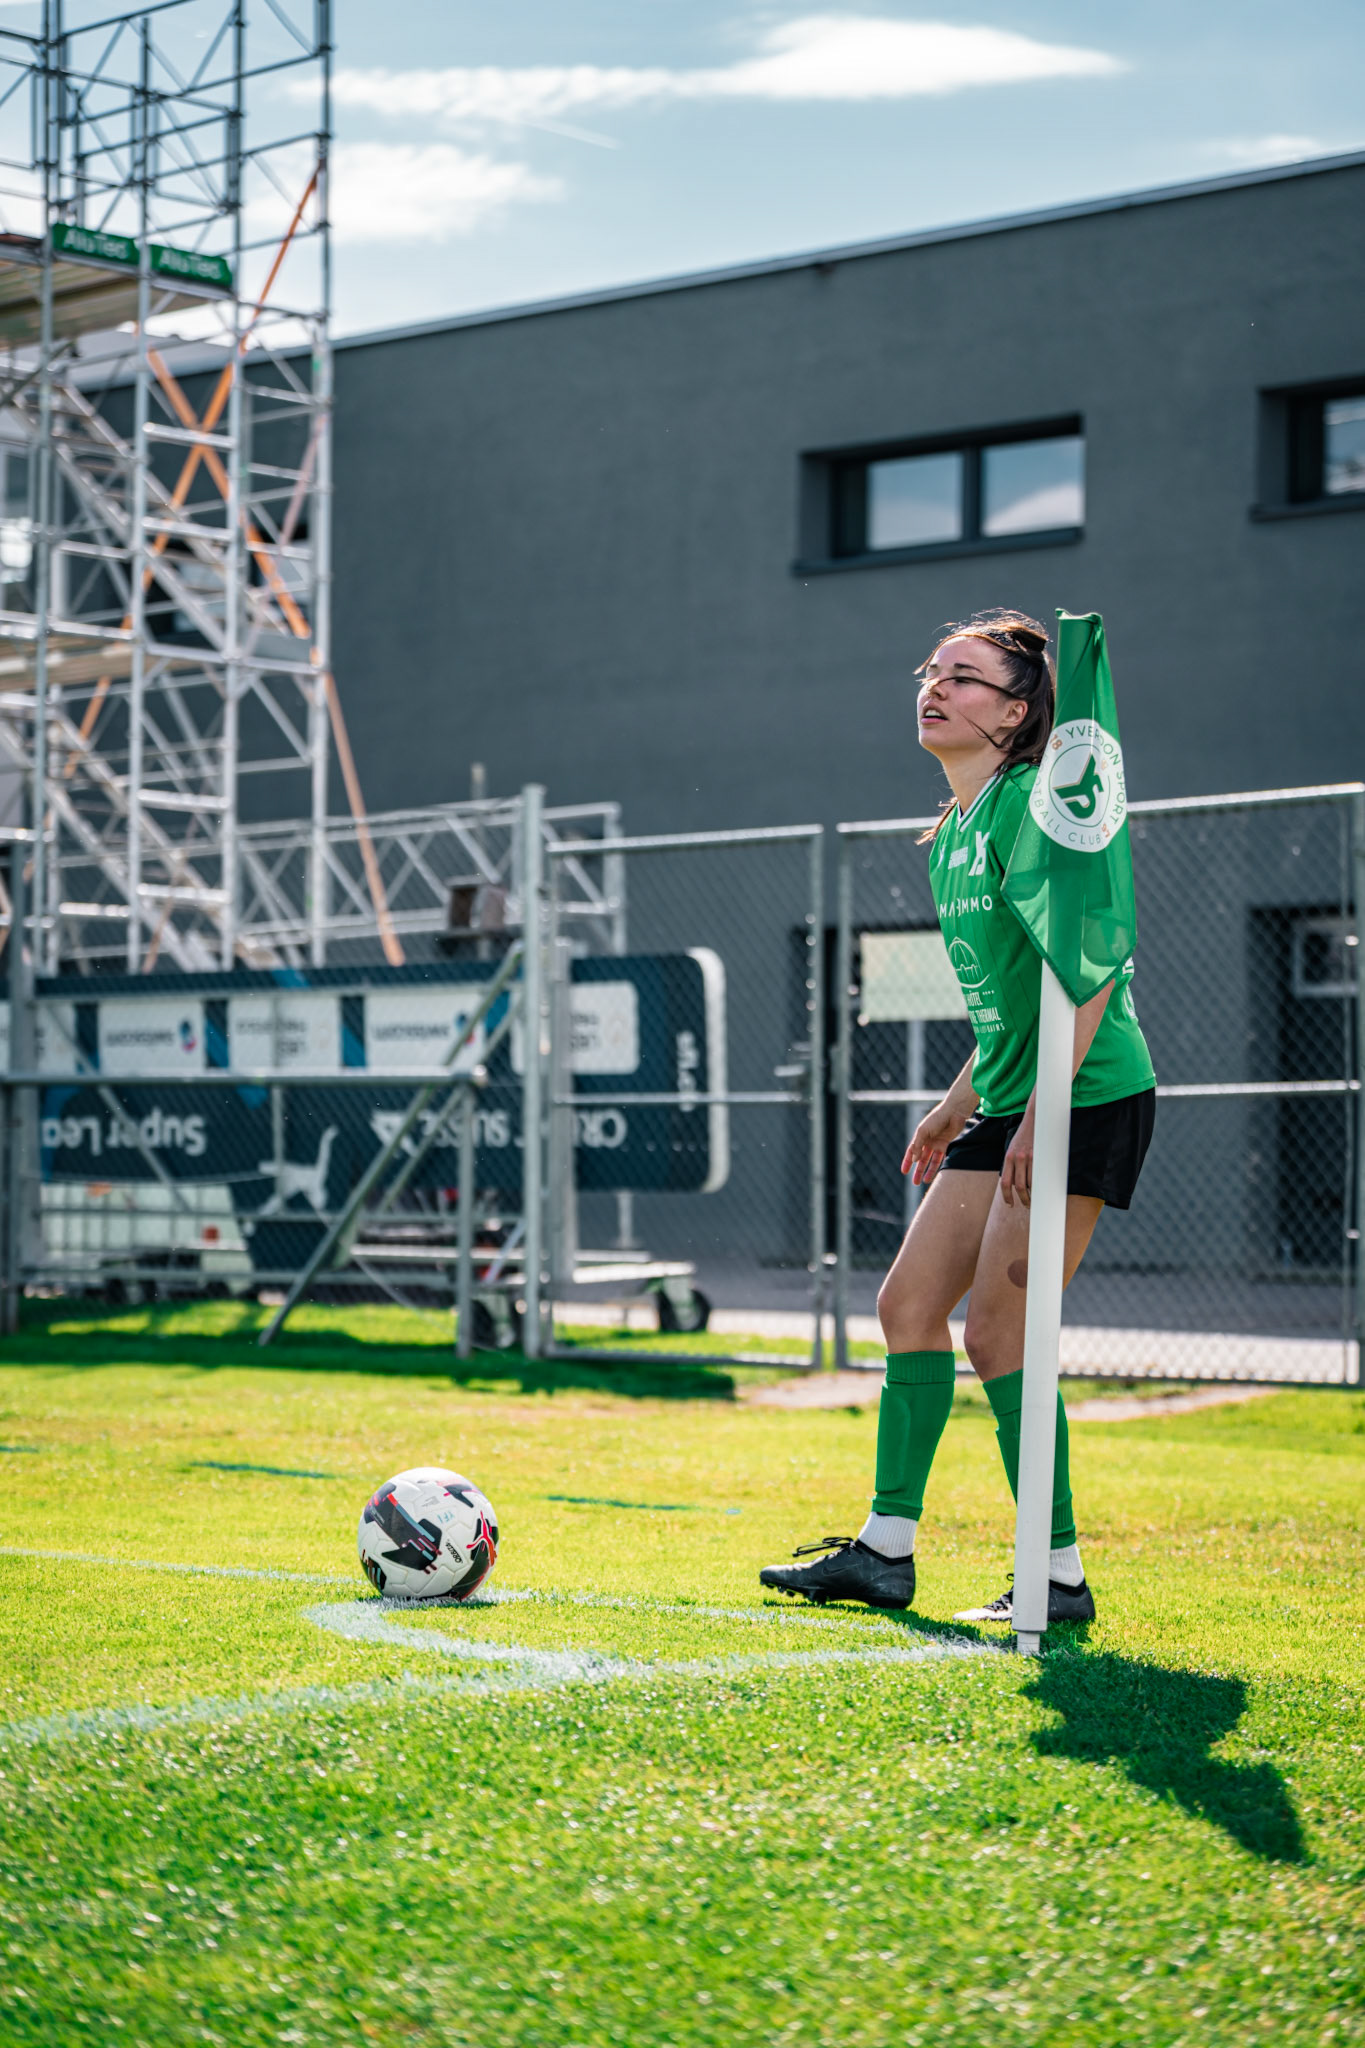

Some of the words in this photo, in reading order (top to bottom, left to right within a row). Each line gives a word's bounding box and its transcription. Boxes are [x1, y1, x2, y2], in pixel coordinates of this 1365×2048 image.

[1110, 771, 1126, 824] SPORT
[1067, 831, 1101, 845] CLUB
[41, 1116, 102, 1156] Lea
[106, 1106, 207, 1156] Super
